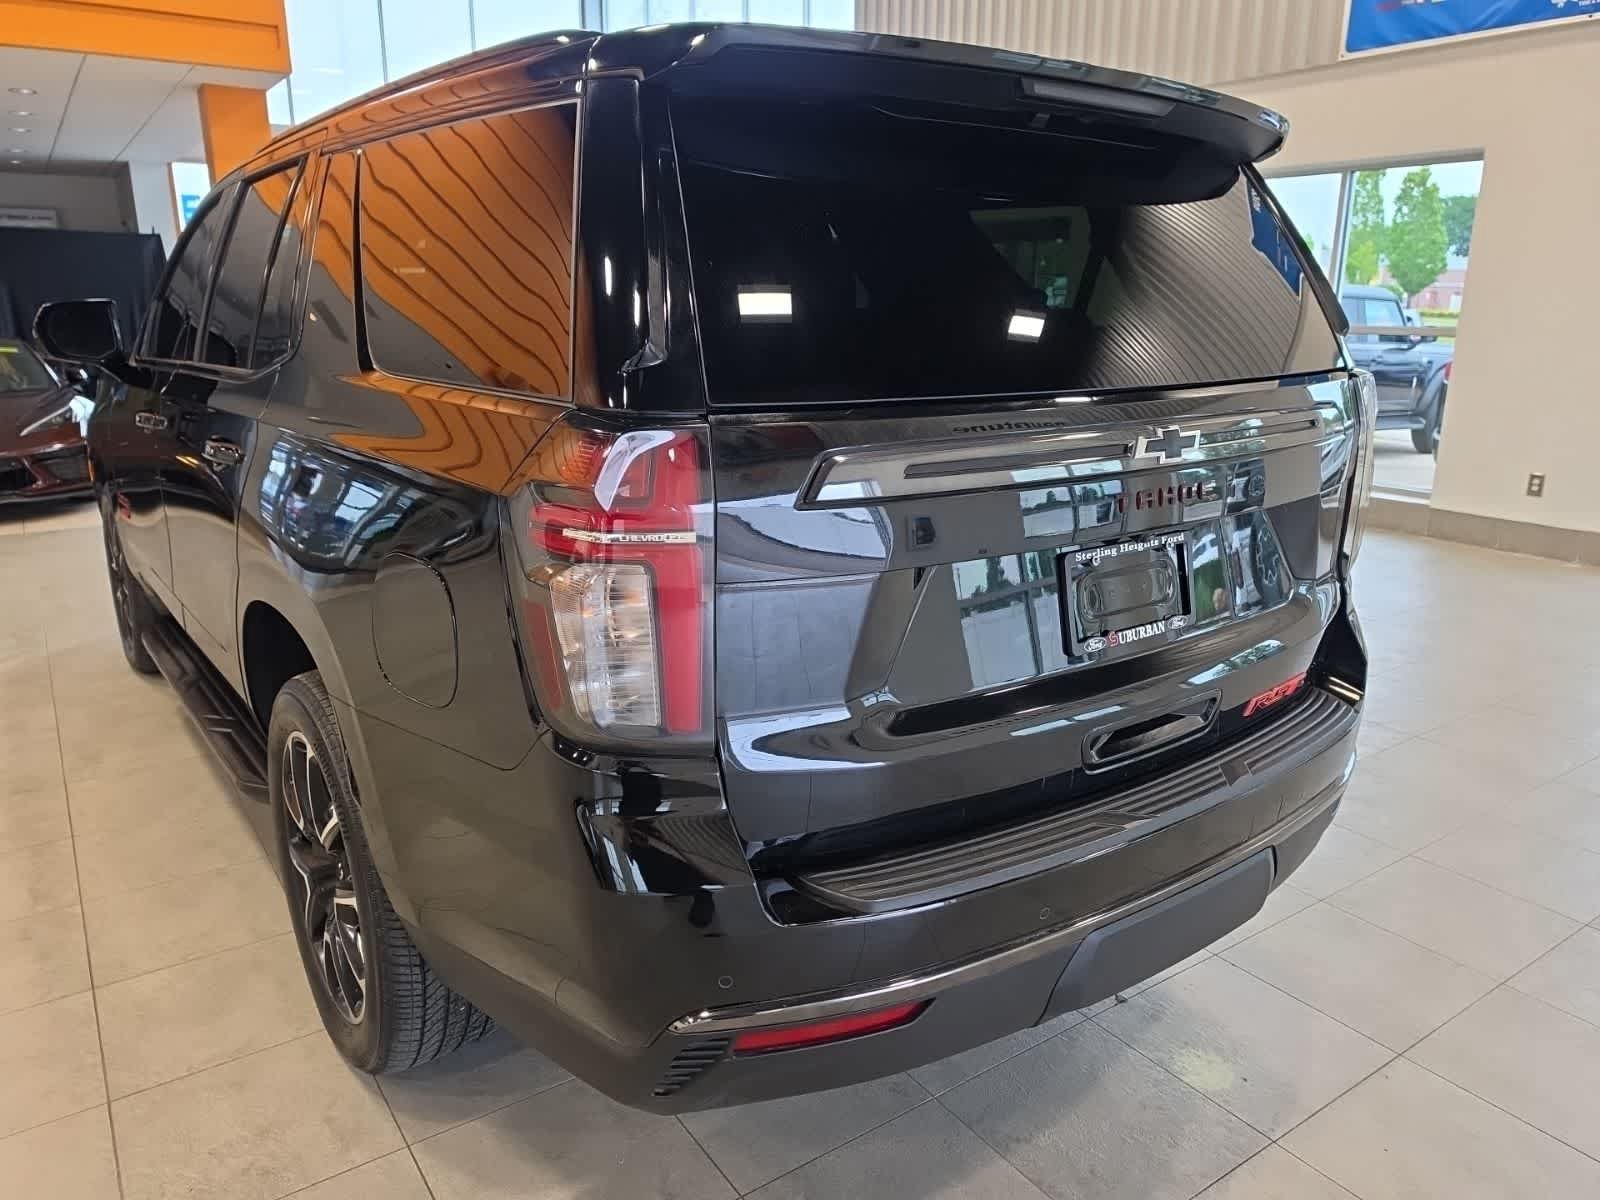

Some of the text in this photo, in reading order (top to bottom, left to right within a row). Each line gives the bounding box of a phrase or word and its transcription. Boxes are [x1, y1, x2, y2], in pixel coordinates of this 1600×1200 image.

[1075, 547, 1118, 562] Sterling
[1161, 532, 1185, 545] Ford
[1109, 620, 1166, 647] SUBURBAN
